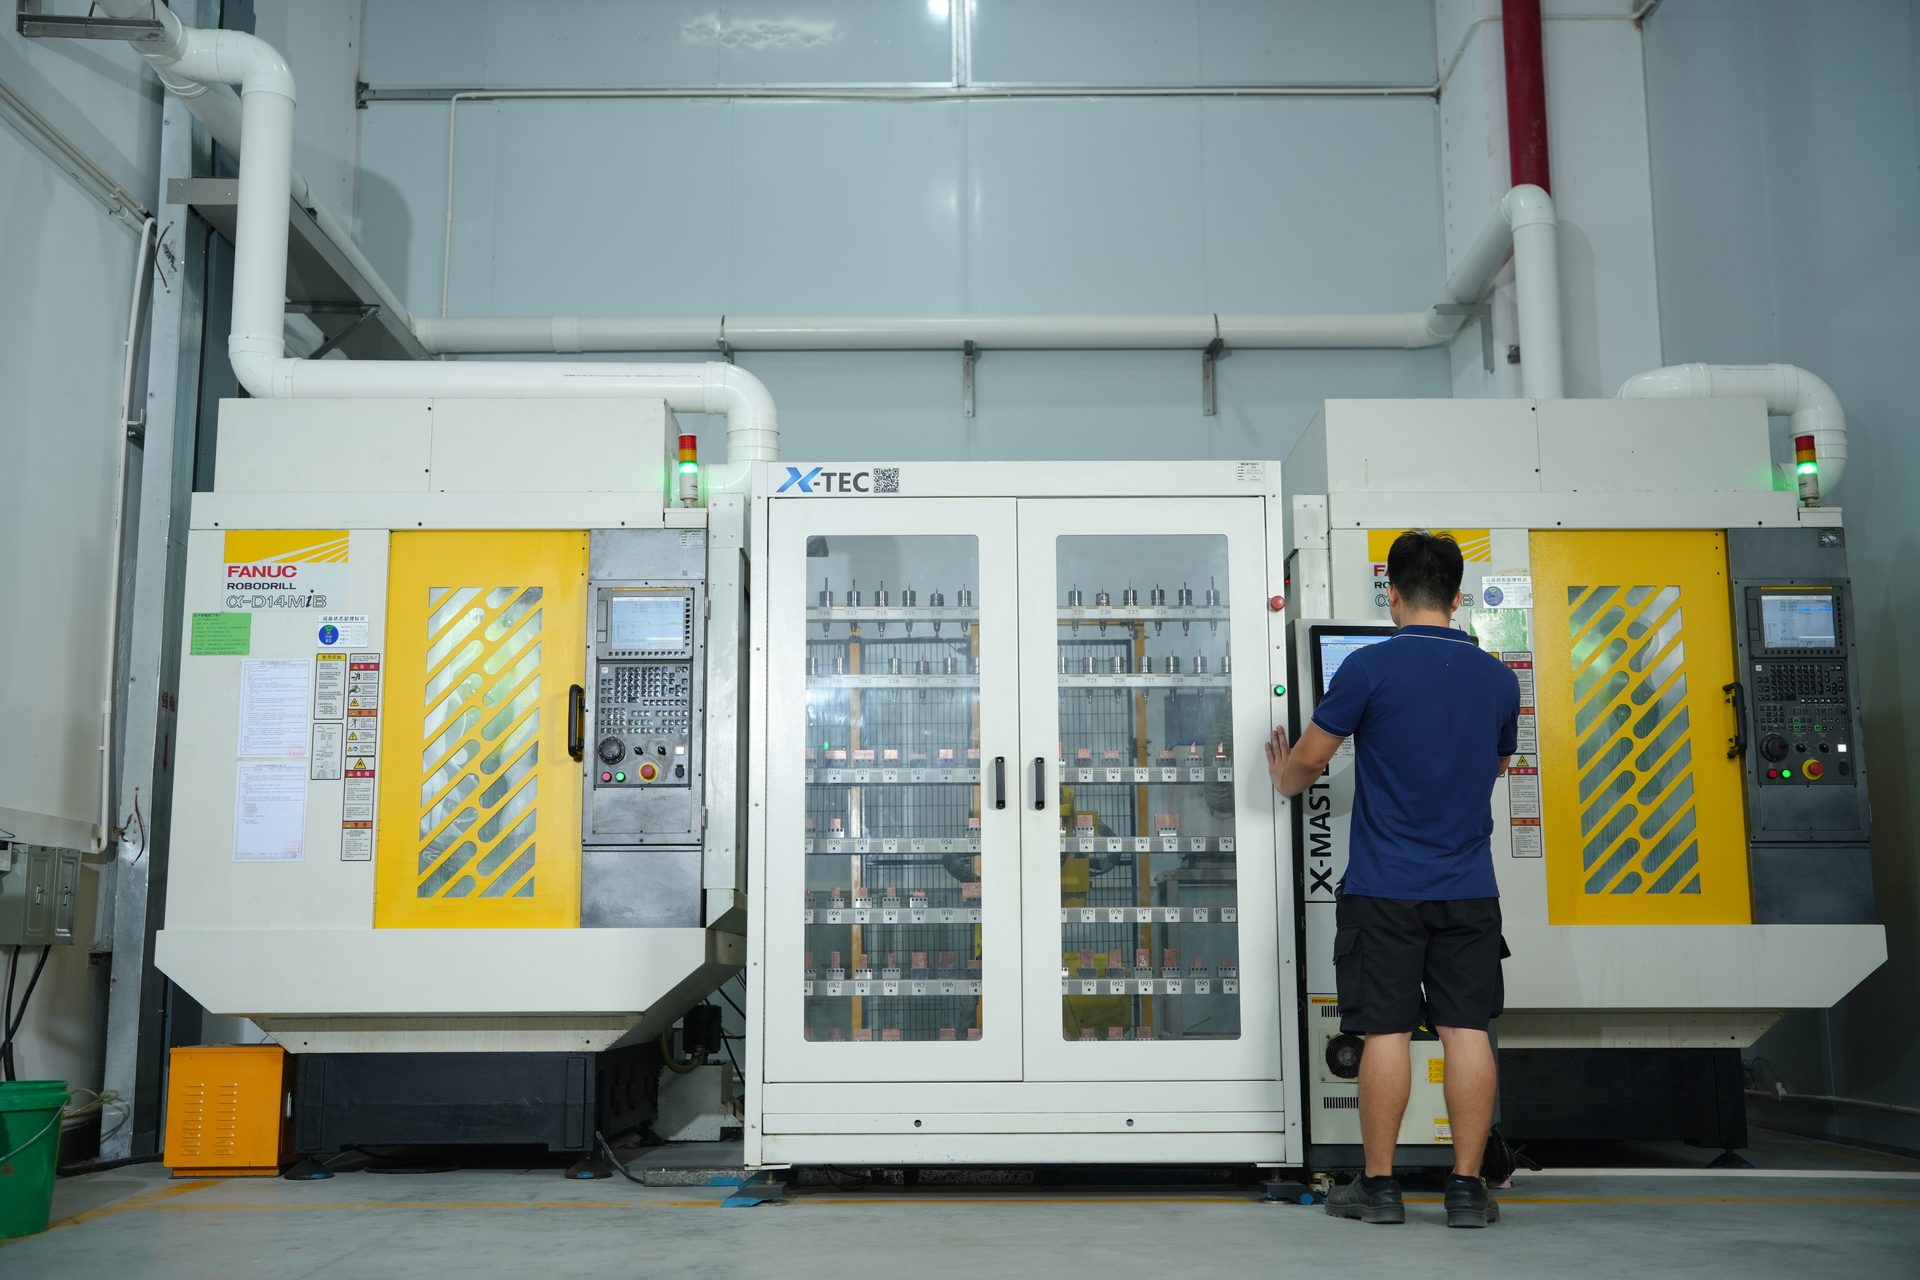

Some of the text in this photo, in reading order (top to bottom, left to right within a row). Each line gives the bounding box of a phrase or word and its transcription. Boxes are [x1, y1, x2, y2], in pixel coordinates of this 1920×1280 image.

[776, 466, 869, 493] X-TEC
[227, 565, 297, 578] FANUC
[227, 582, 296, 590] ROBODRILL
[1308, 763, 1333, 895] X-MAST
